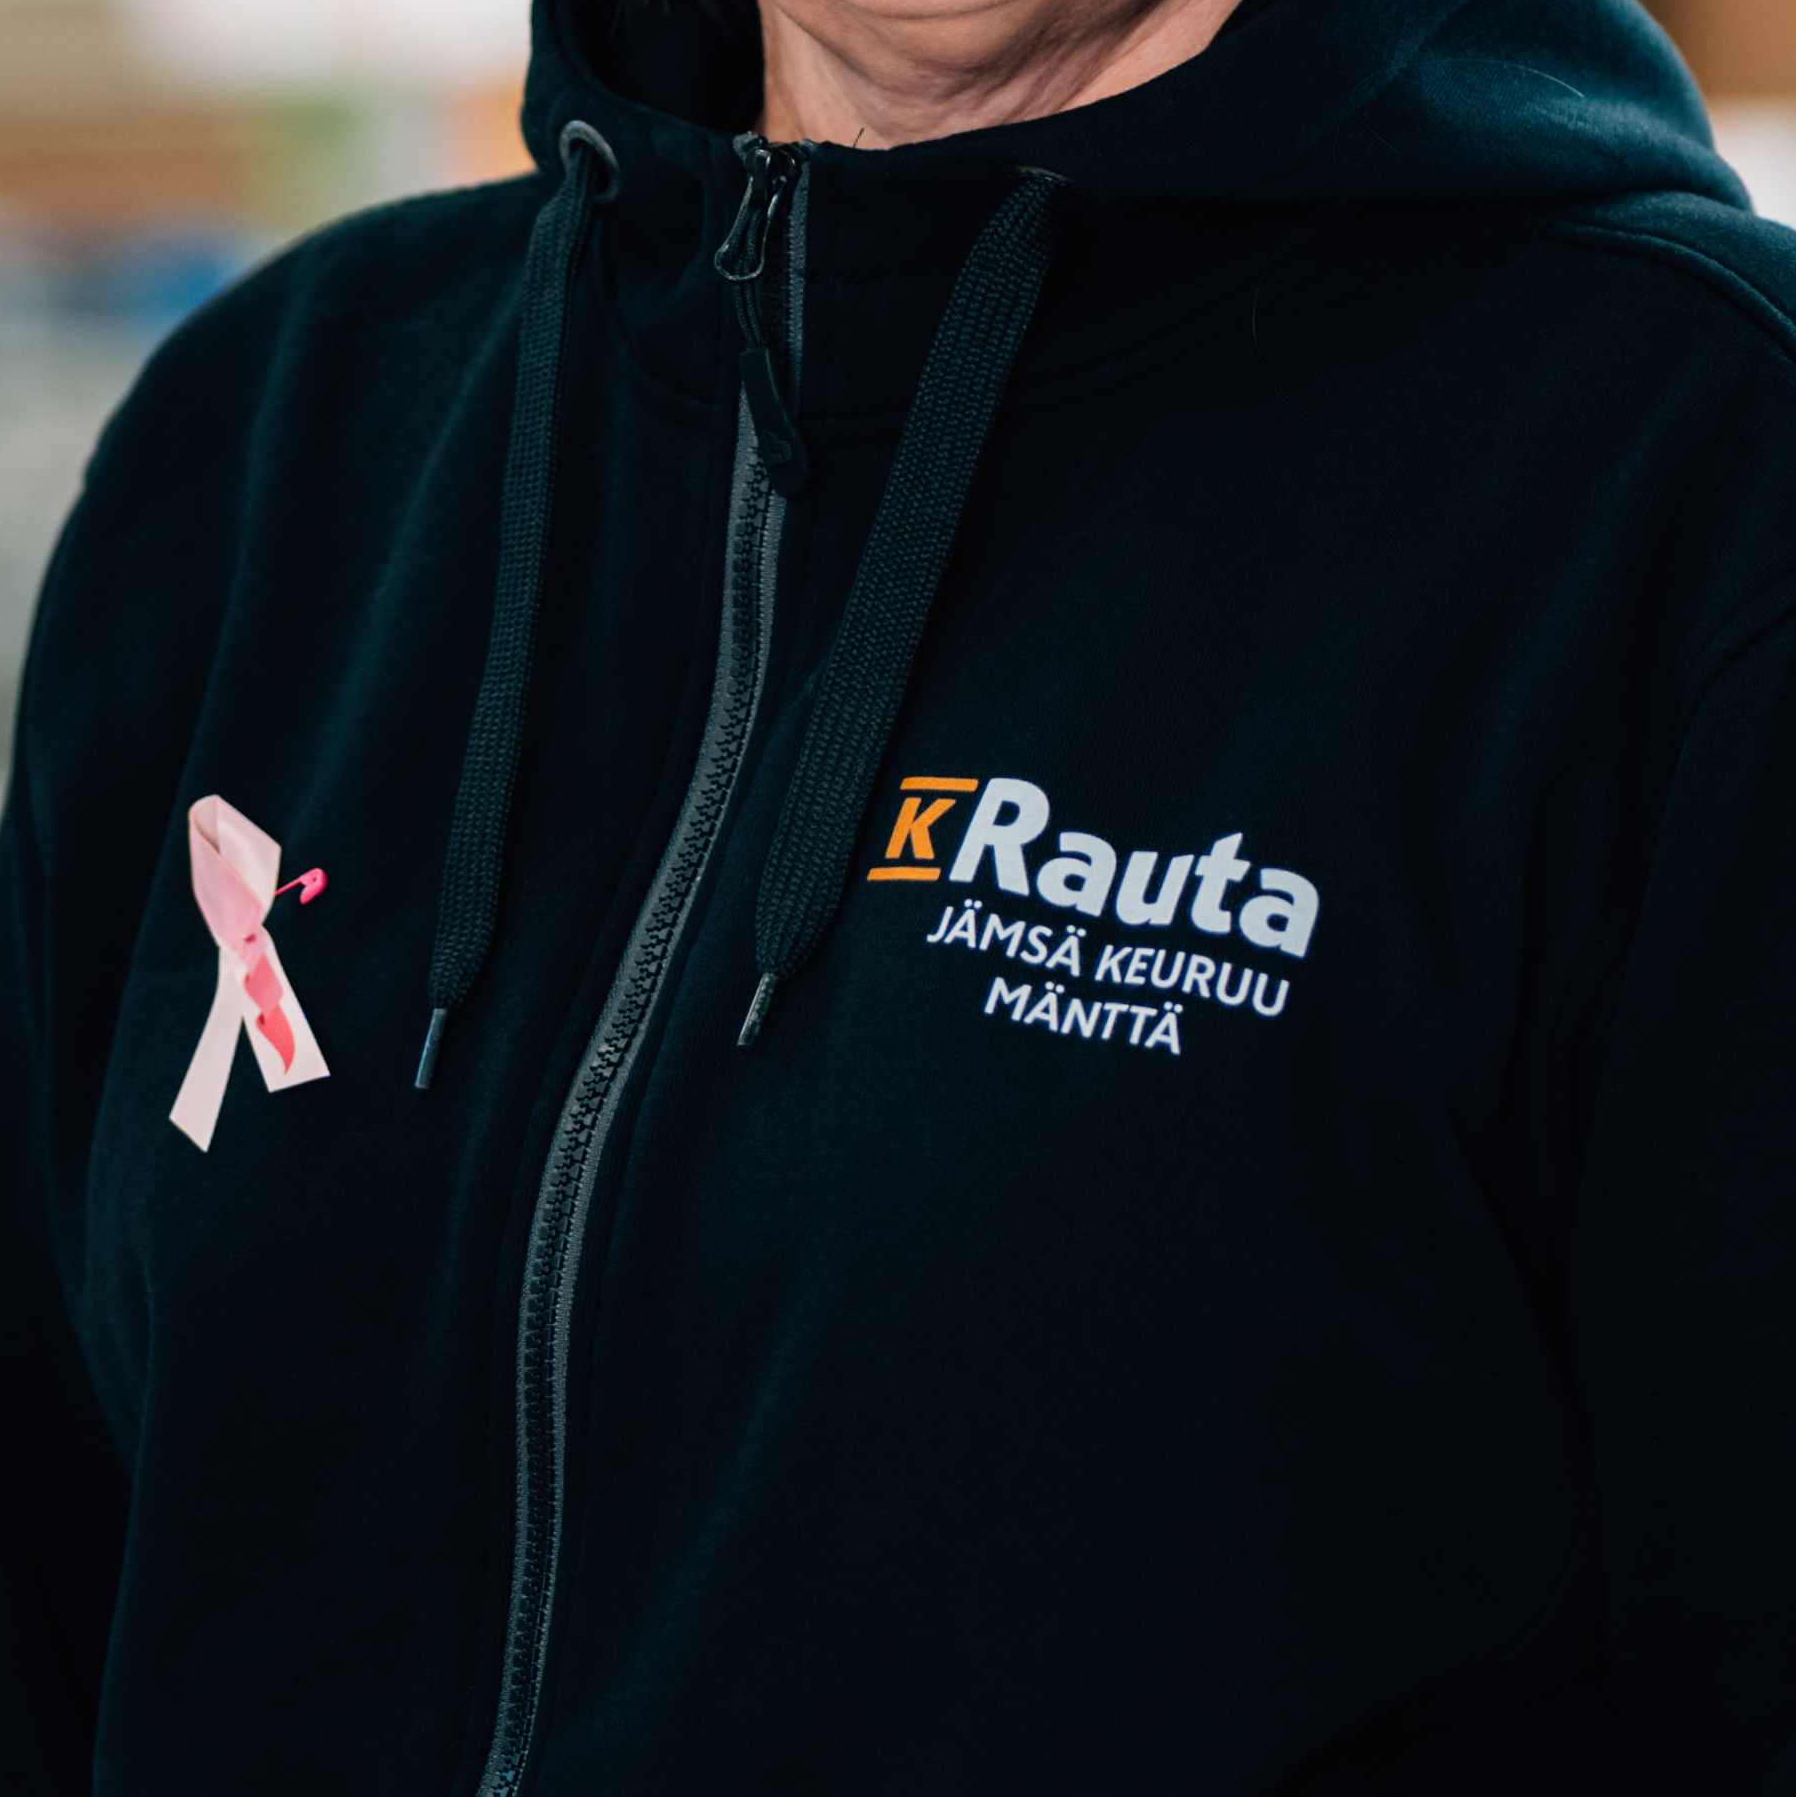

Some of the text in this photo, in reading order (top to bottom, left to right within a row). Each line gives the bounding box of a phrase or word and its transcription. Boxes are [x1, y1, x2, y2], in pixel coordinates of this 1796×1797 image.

[925, 898, 1290, 1018] JÄMSÄ KEURUU
[983, 976, 1184, 1055] MÄNTTÄ
